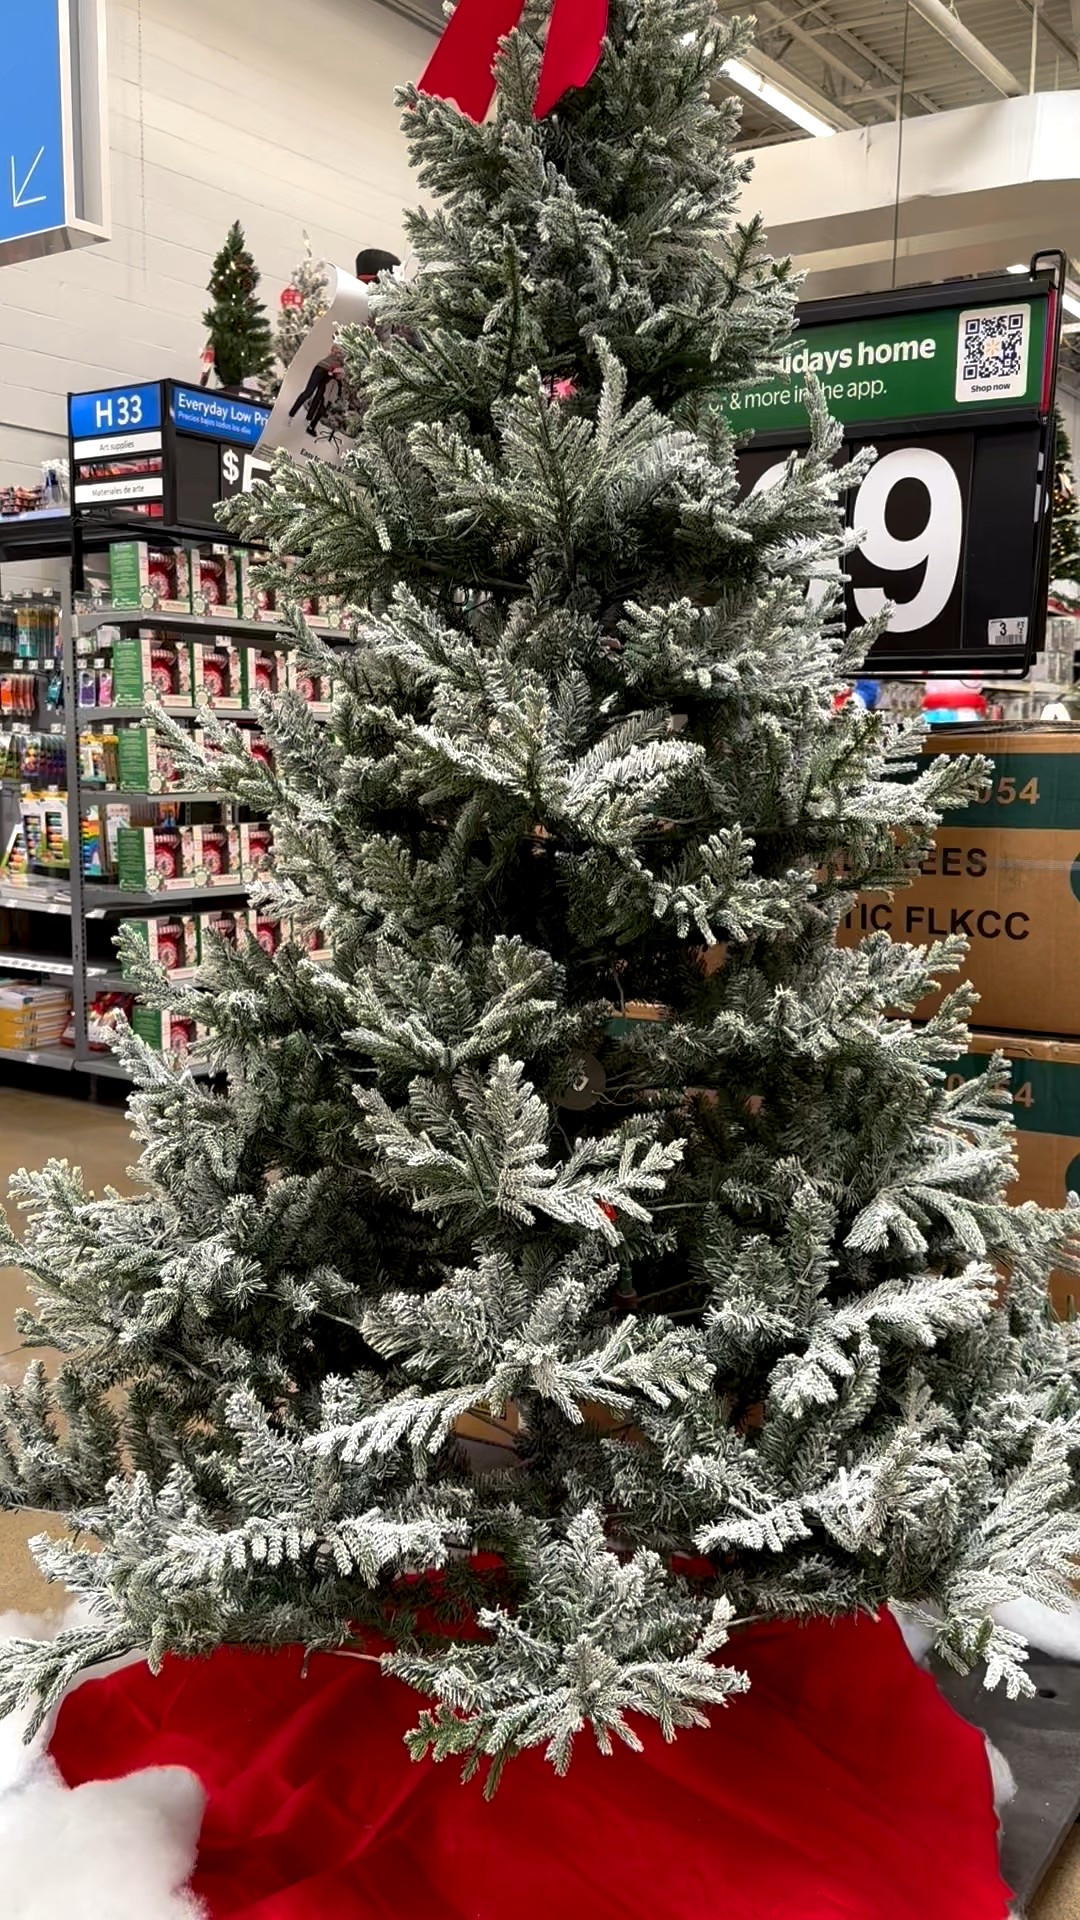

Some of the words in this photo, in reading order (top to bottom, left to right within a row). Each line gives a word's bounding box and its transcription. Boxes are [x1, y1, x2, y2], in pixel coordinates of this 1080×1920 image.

[857, 337, 936, 365] home
[729, 392, 742, 410] &
[745, 389, 791, 409] more
[819, 382, 844, 400] he
[847, 379, 887, 400] app.
[971, 384, 992, 393] Shop
[993, 383, 1011, 391] now
[178, 393, 228, 421] Everyday
[230, 406, 252, 423] Low
[99, 443, 109, 452] Art
[110, 440, 135, 452] supplies
[123, 485, 132, 494] de
[906, 906, 1030, 941] FLKCC
